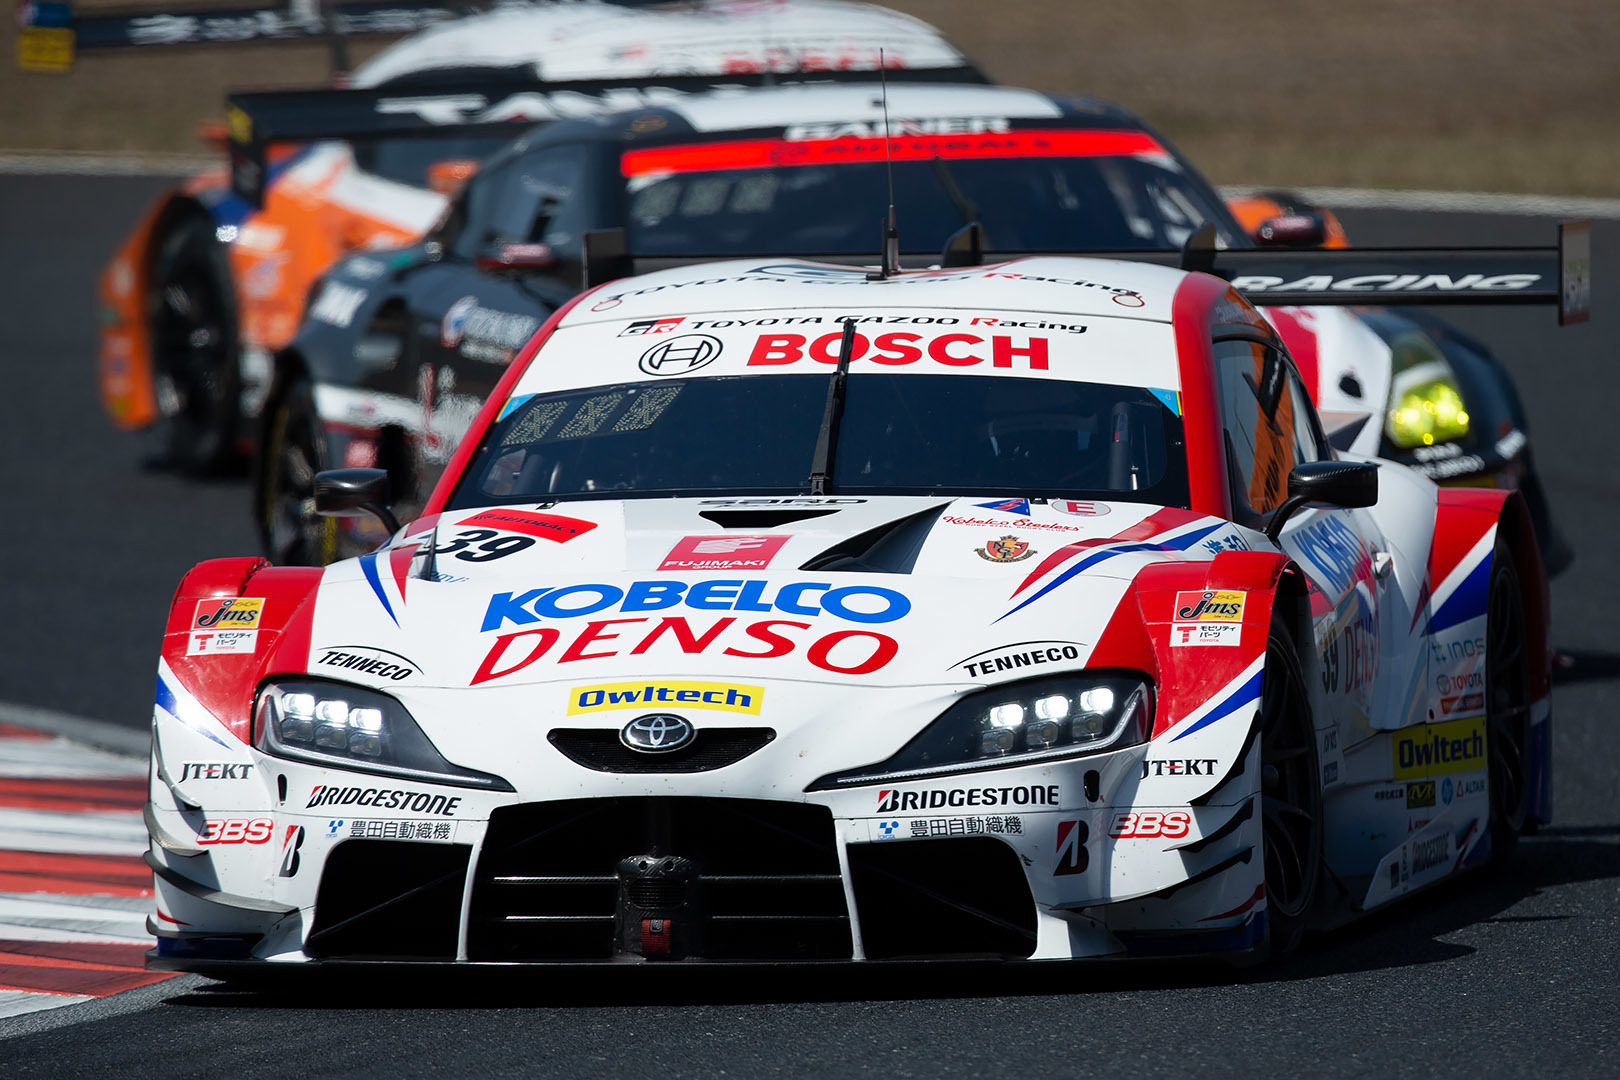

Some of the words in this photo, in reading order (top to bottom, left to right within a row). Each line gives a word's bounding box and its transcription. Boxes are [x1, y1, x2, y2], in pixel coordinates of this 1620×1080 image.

[1231, 274, 1541, 292] RACING
[692, 317, 822, 330] TOYOTA
[834, 315, 960, 326] GAZOO
[970, 316, 1088, 334] Racing
[747, 332, 1049, 371] BOSCH
[493, 515, 581, 534] AUTOBACS
[943, 516, 1009, 526] Kobelco
[1012, 518, 1080, 532] Steelers
[432, 529, 537, 563] 39
[480, 579, 911, 633] KOBELCO
[318, 649, 414, 681] TENNECO
[469, 616, 899, 687] DENSO
[963, 644, 1079, 678] TENNECO
[578, 686, 752, 709] Owltech
[1399, 729, 1483, 769] Owltech
[179, 762, 254, 783] JTEKT
[1139, 759, 1219, 780] JTEKT
[306, 784, 463, 816] BRIDGESTONE
[876, 784, 1060, 813] BRIDGESTONE
[196, 818, 274, 845] BBS
[349, 820, 451, 840] 豊田自動織機
[909, 815, 1022, 838] 豊田自動織機
[1108, 811, 1191, 839] BBS
